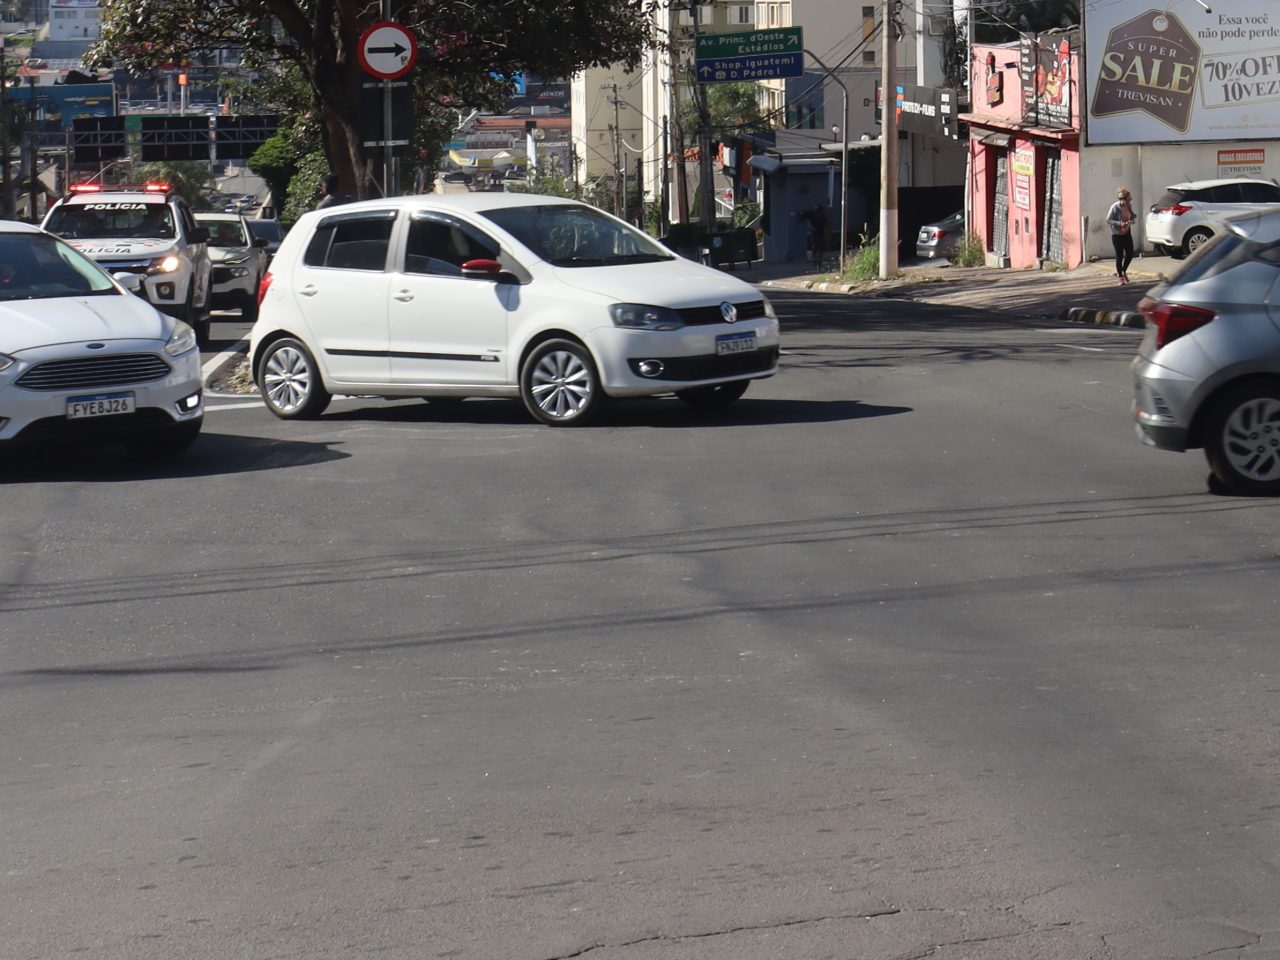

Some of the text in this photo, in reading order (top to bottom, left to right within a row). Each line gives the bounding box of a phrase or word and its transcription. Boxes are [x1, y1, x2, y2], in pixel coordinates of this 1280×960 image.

[1218, 13, 1269, 25] Essa você
[1198, 27, 1218, 38] não
[1220, 26, 1247, 40] pode
[738, 42, 785, 53] Estádios
[1127, 41, 1178, 58] SUPER
[714, 56, 794, 71] Shop. Iguatemi
[743, 69, 774, 78] Pedro
[1101, 51, 1195, 95] SALE
[1116, 88, 1174, 107] TREVISAN
[83, 202, 147, 212] POLÍCIA
[73, 399, 129, 416] FYE8J26
